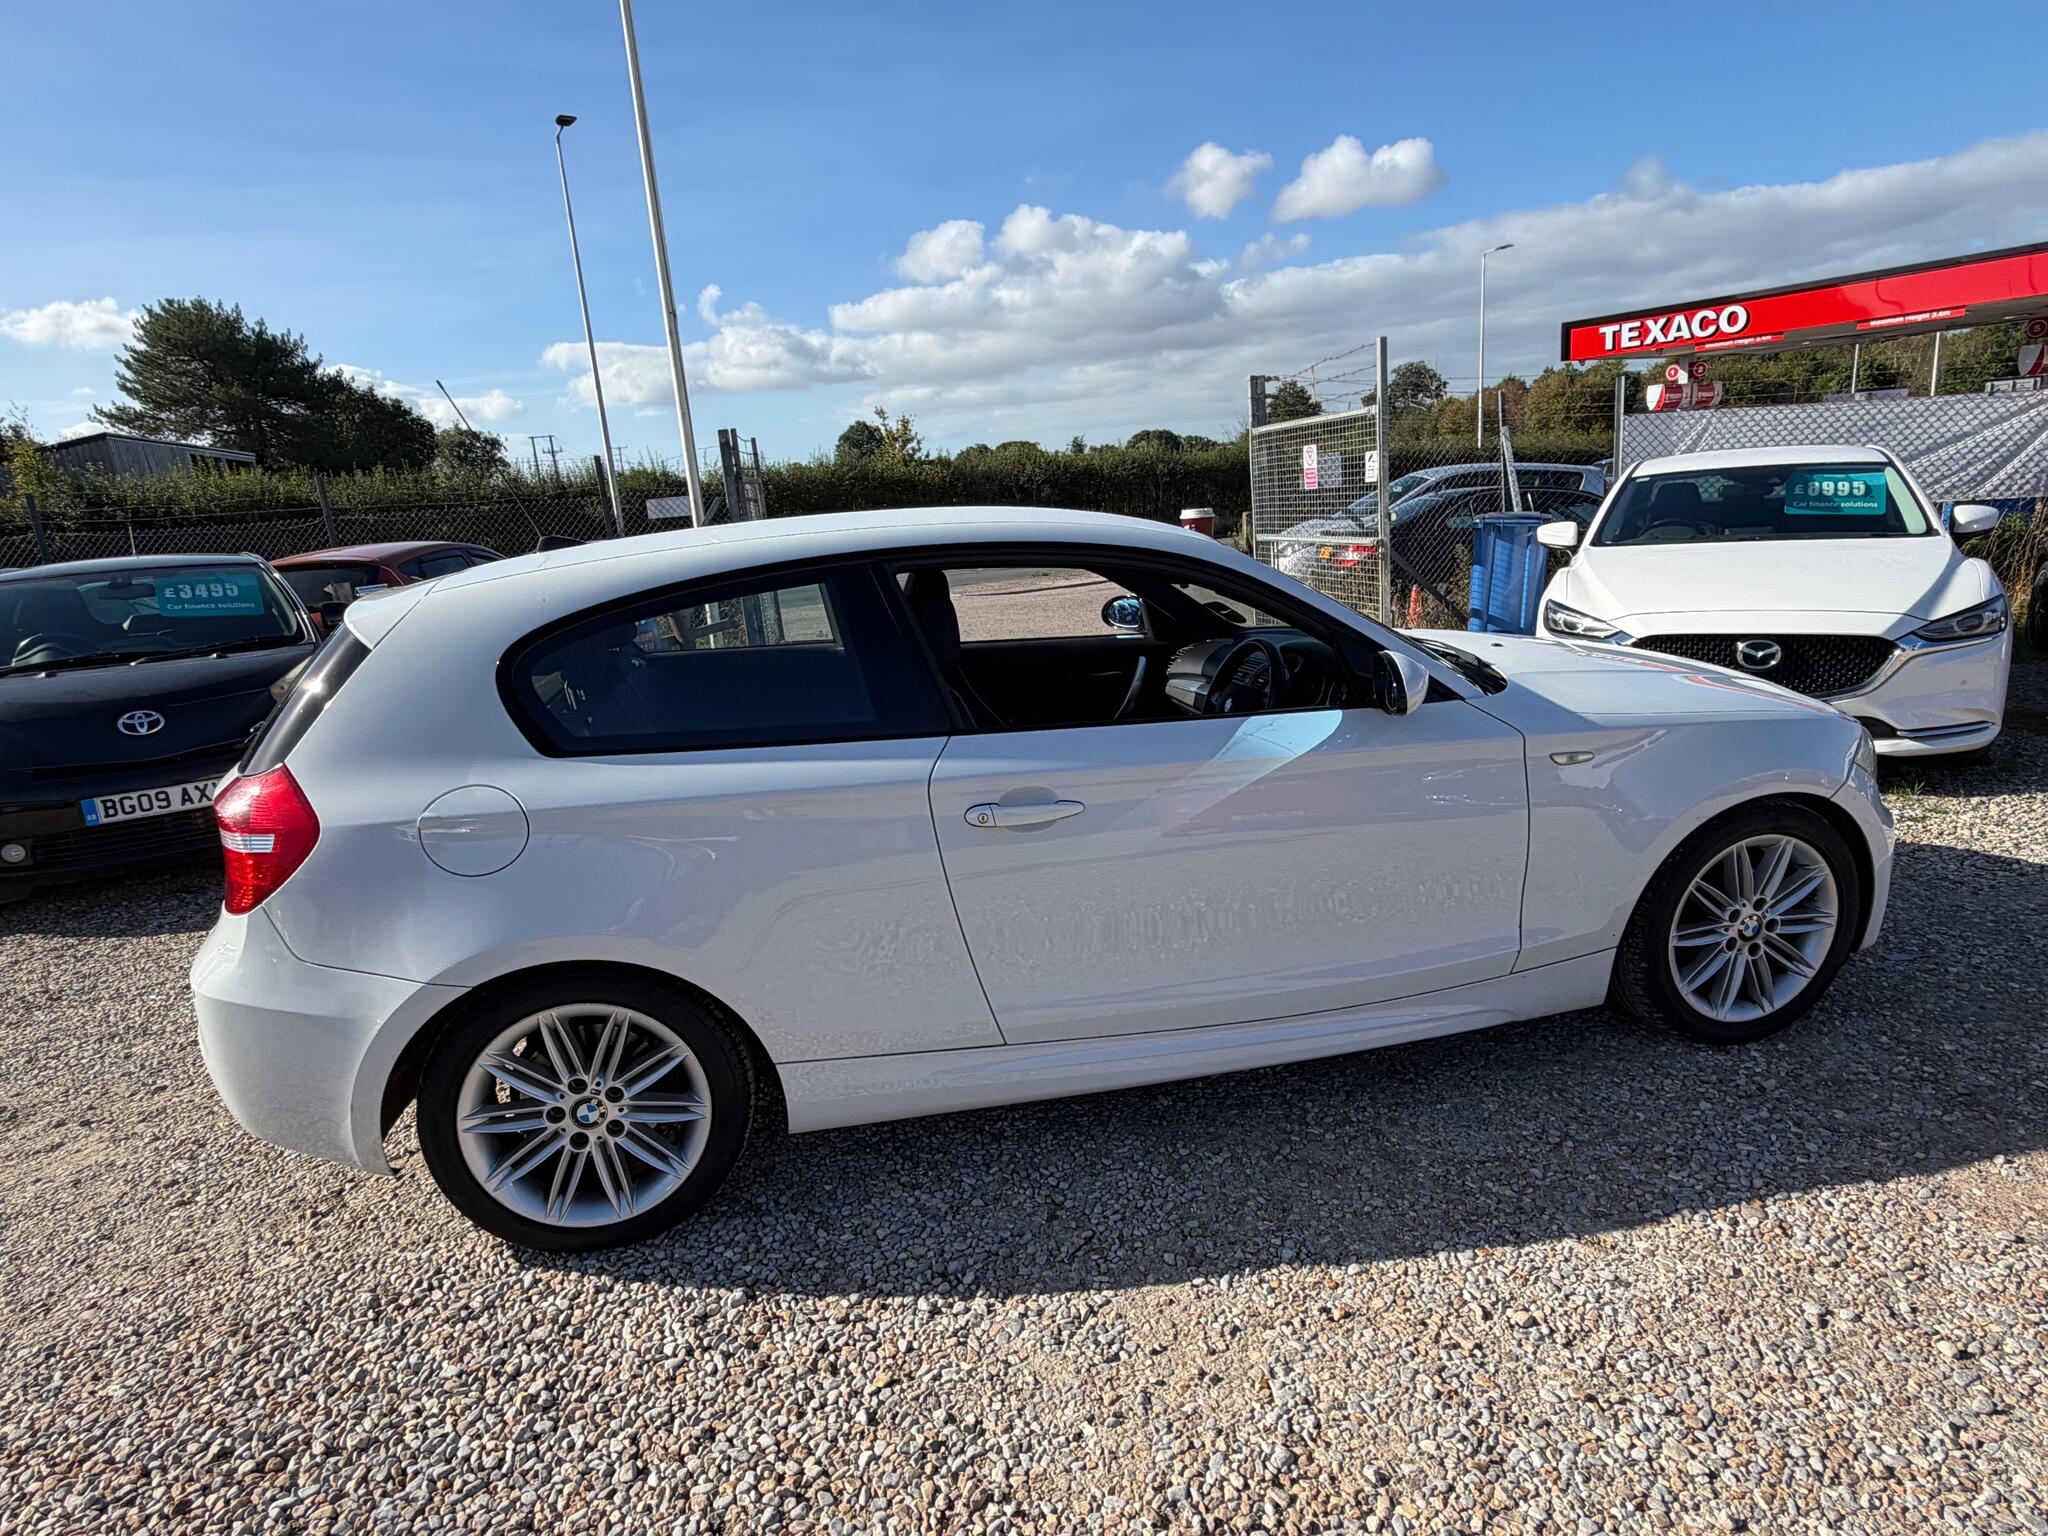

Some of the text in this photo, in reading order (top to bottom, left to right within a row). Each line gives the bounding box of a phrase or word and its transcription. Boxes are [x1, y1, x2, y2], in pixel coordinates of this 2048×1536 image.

[1599, 305, 1748, 350] TEXACO
[1840, 500, 1878, 508] solutions
[218, 601, 255, 609] solutions
[100, 790, 171, 819] BG09
